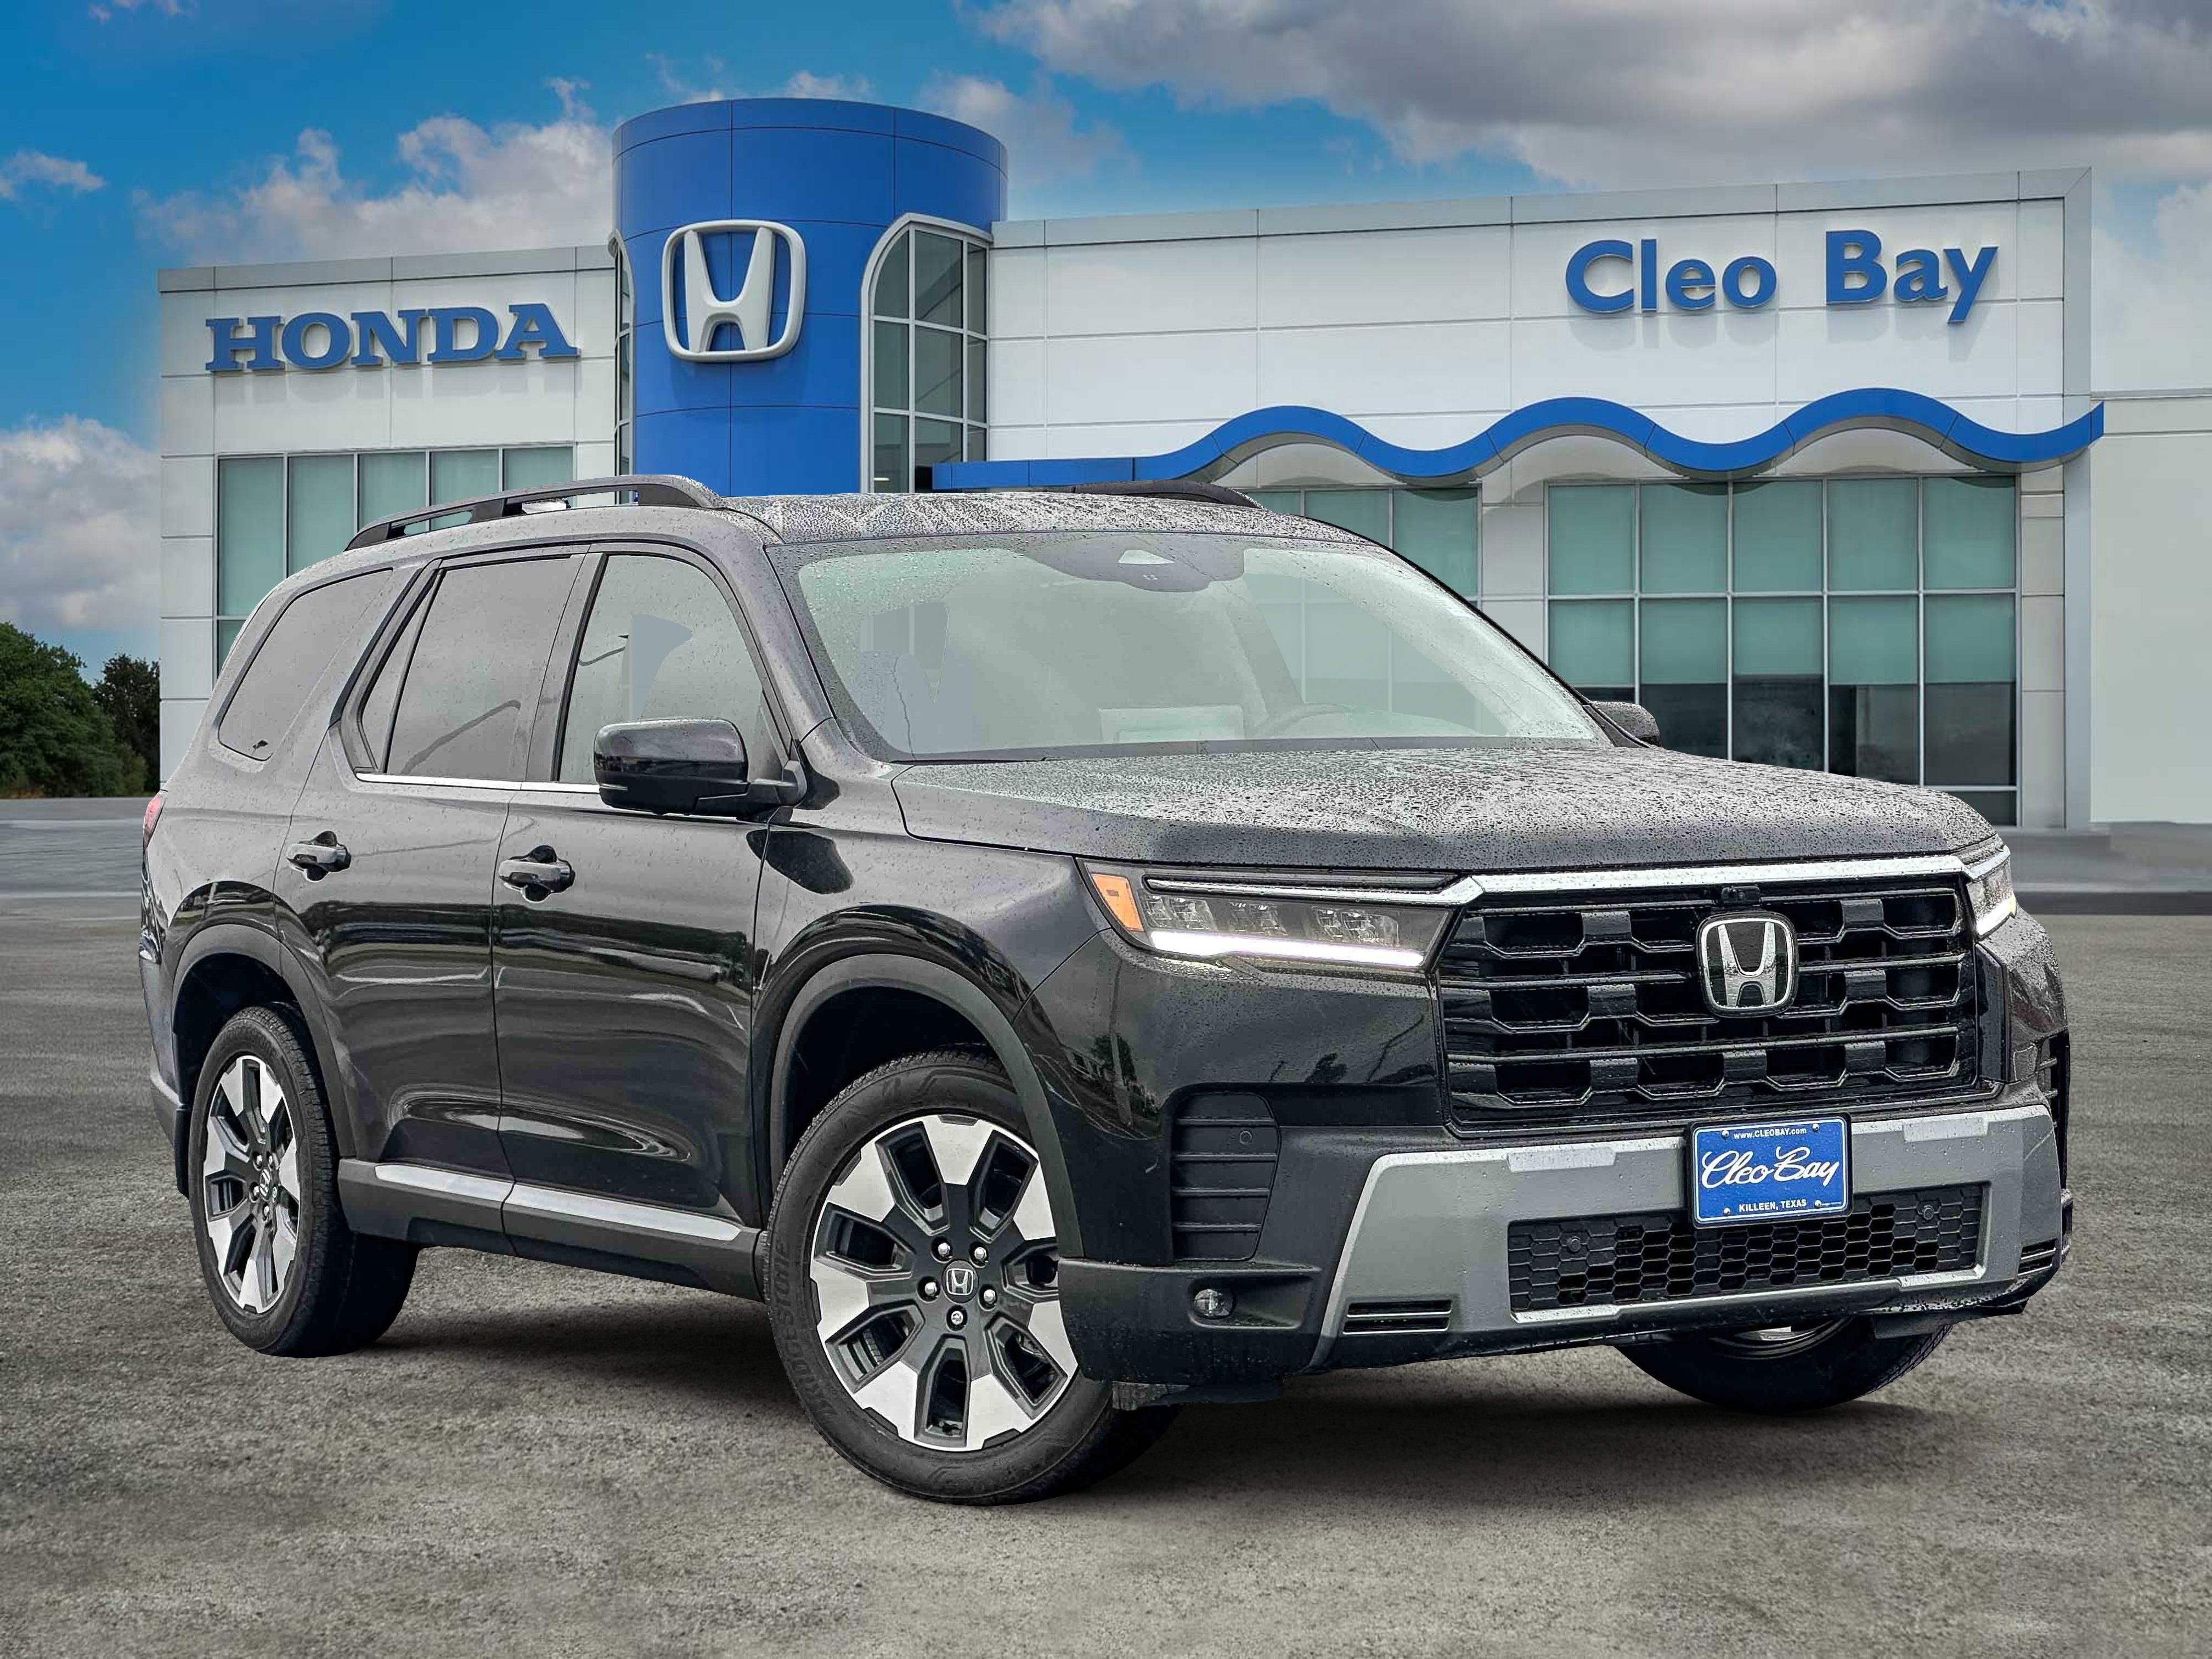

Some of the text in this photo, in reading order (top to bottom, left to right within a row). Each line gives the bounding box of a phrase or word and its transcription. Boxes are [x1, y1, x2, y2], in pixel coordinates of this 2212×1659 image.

[1566, 229, 1999, 324] Cleo Bay
[205, 303, 582, 373] HONDA
[1733, 1128, 1807, 1139] www.CLEOBAY.com
[1702, 1147, 1839, 1189] Cleo Bay
[1739, 1199, 1807, 1212] KILLEEN, TEXAS
